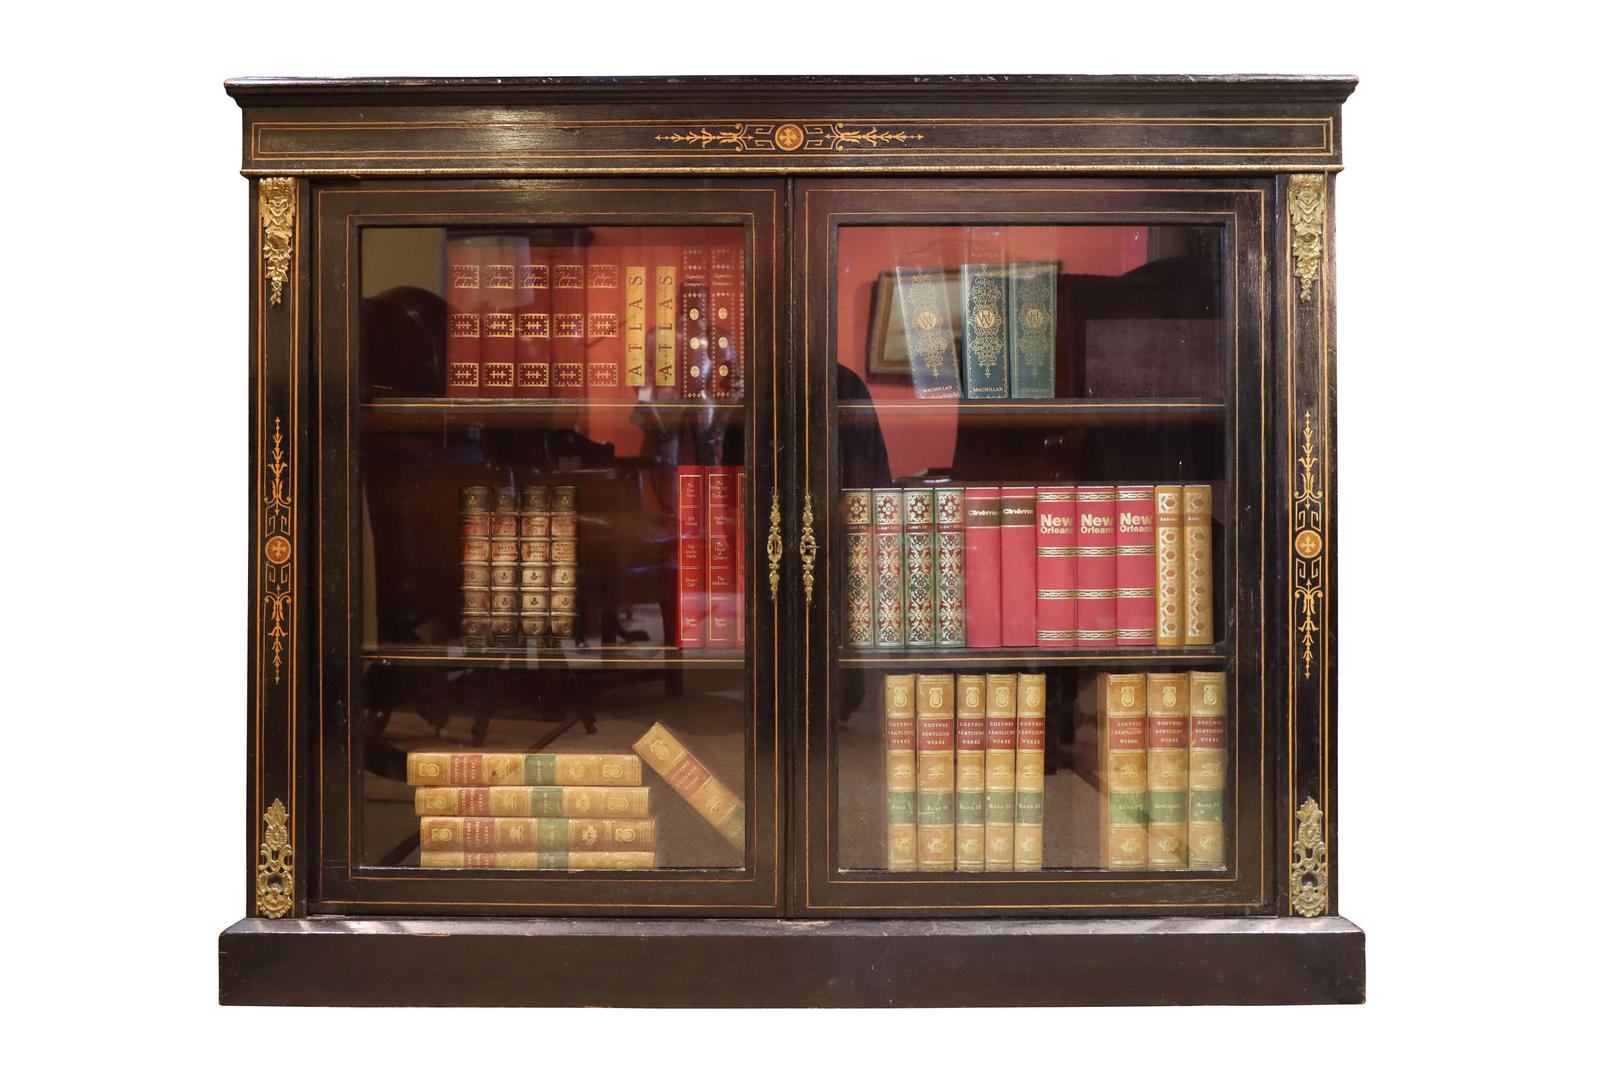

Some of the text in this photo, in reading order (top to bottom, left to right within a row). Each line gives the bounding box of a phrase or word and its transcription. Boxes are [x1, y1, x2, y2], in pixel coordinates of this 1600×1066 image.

[628, 275, 643, 377] ATLAS
[658, 275, 673, 377] ATLAS
[922, 385, 953, 393] MACMILLAN
[1040, 514, 1073, 526] New
[1081, 514, 1114, 526] New
[1120, 513, 1153, 525] New
